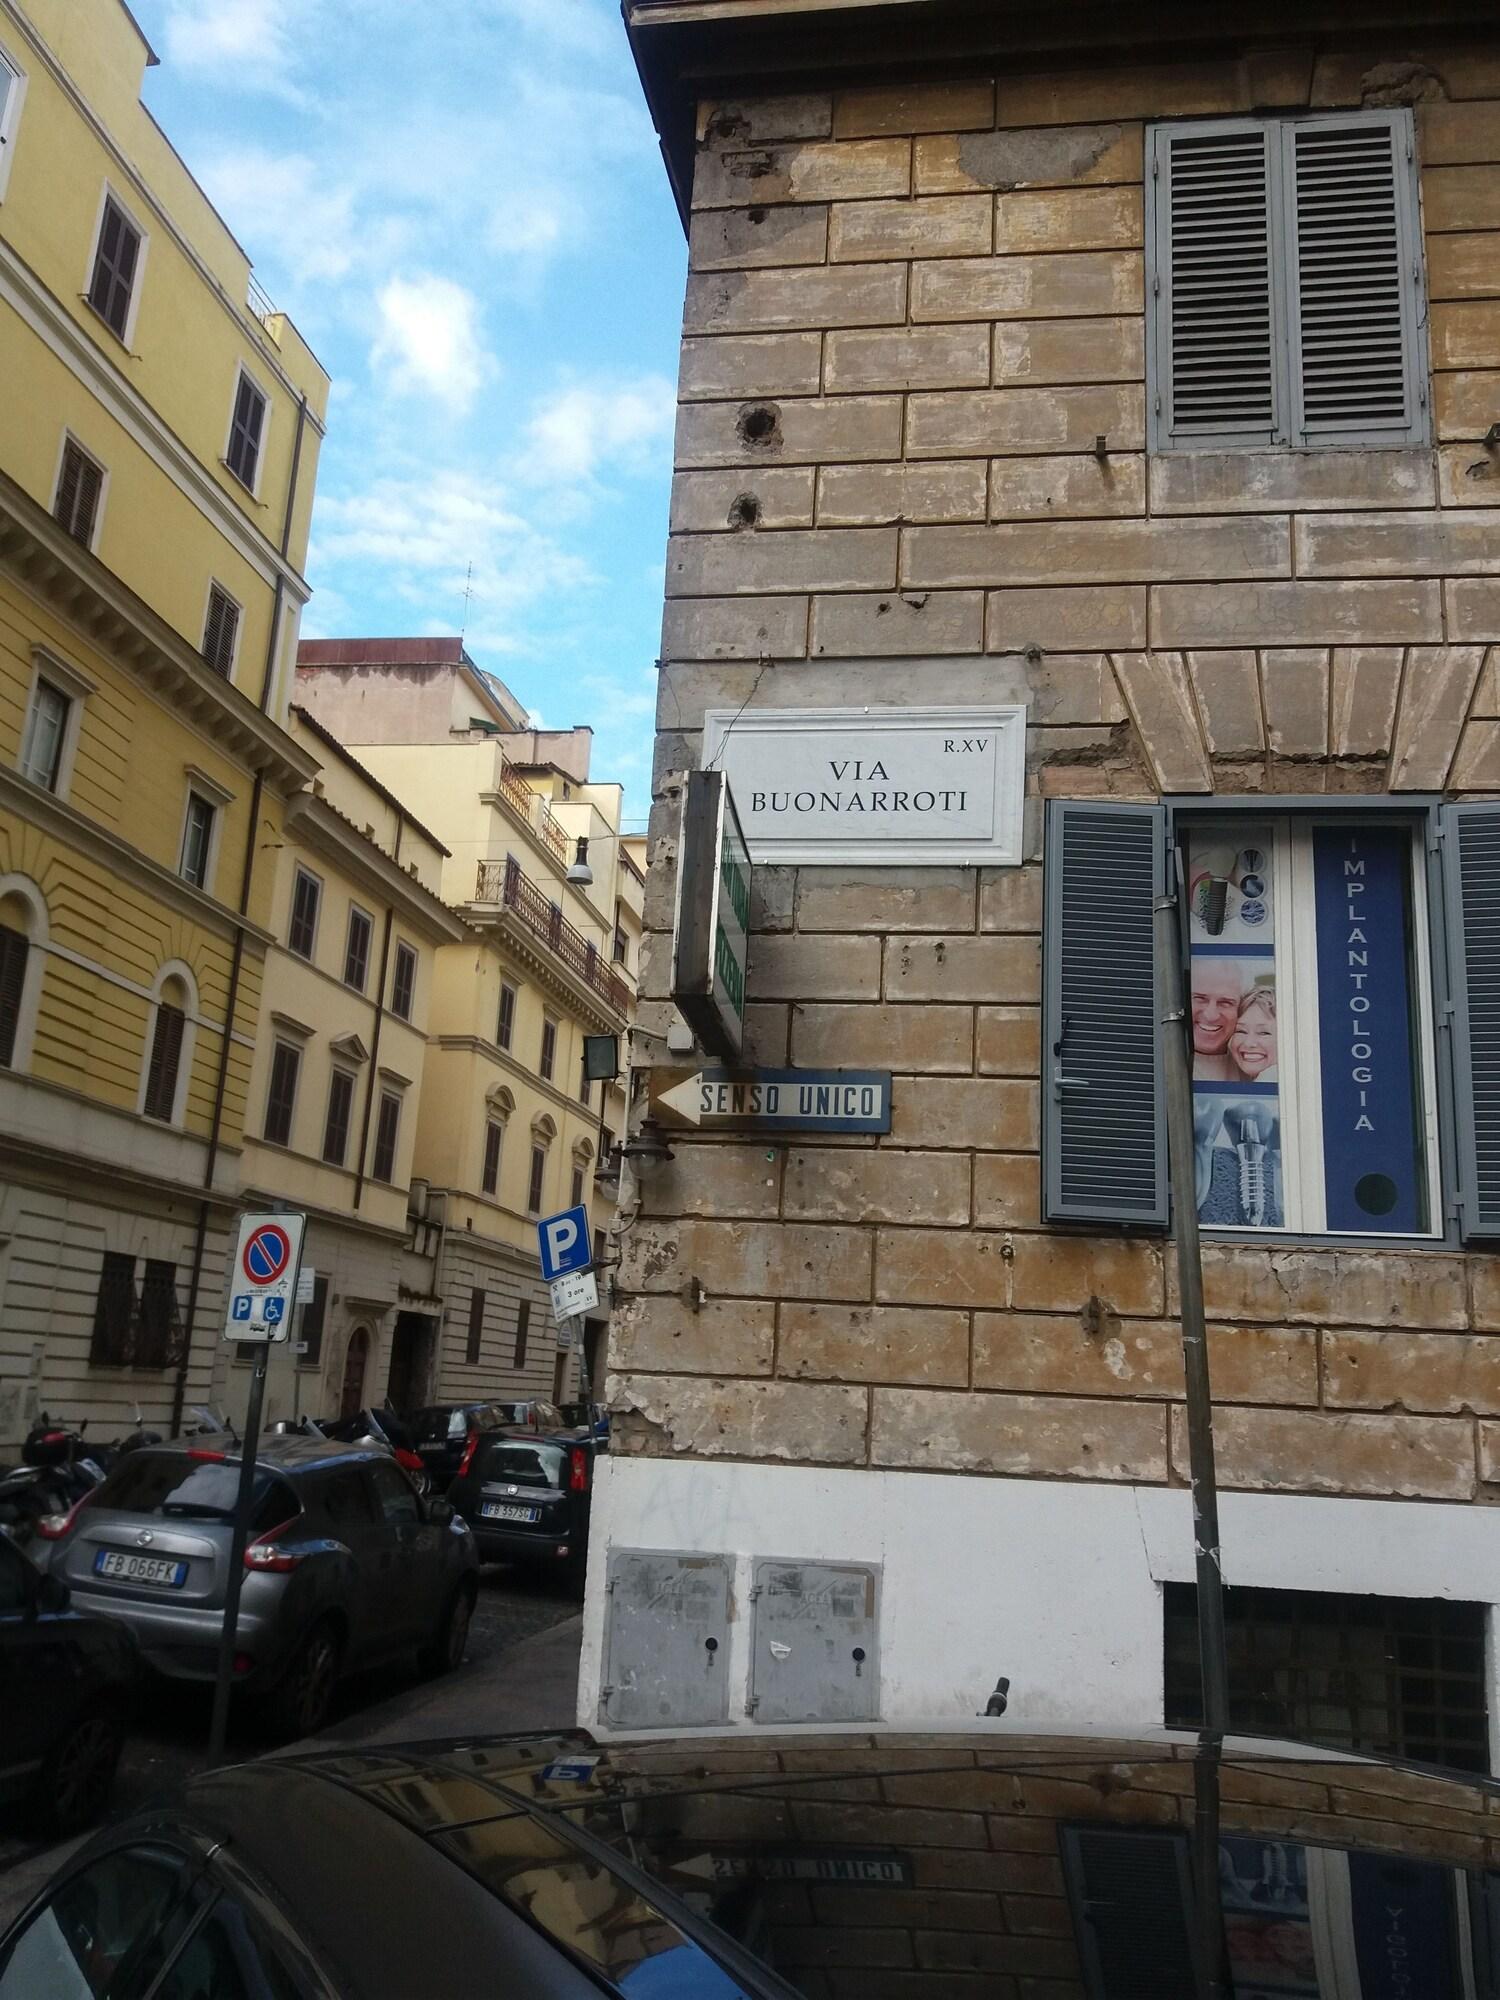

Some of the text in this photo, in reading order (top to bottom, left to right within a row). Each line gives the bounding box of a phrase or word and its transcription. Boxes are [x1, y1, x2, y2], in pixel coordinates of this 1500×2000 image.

[943, 738, 989, 754] R.XV
[829, 760, 890, 781] VIA
[751, 790, 968, 813] BUONARROTI
[1343, 837, 1375, 1132] IMPLANTOLOGIA
[699, 1083, 875, 1117] SENSO UNICO
[546, 1218, 578, 1272] P
[236, 1298, 249, 1318] P
[103, 1554, 177, 1581] FB 066FK
